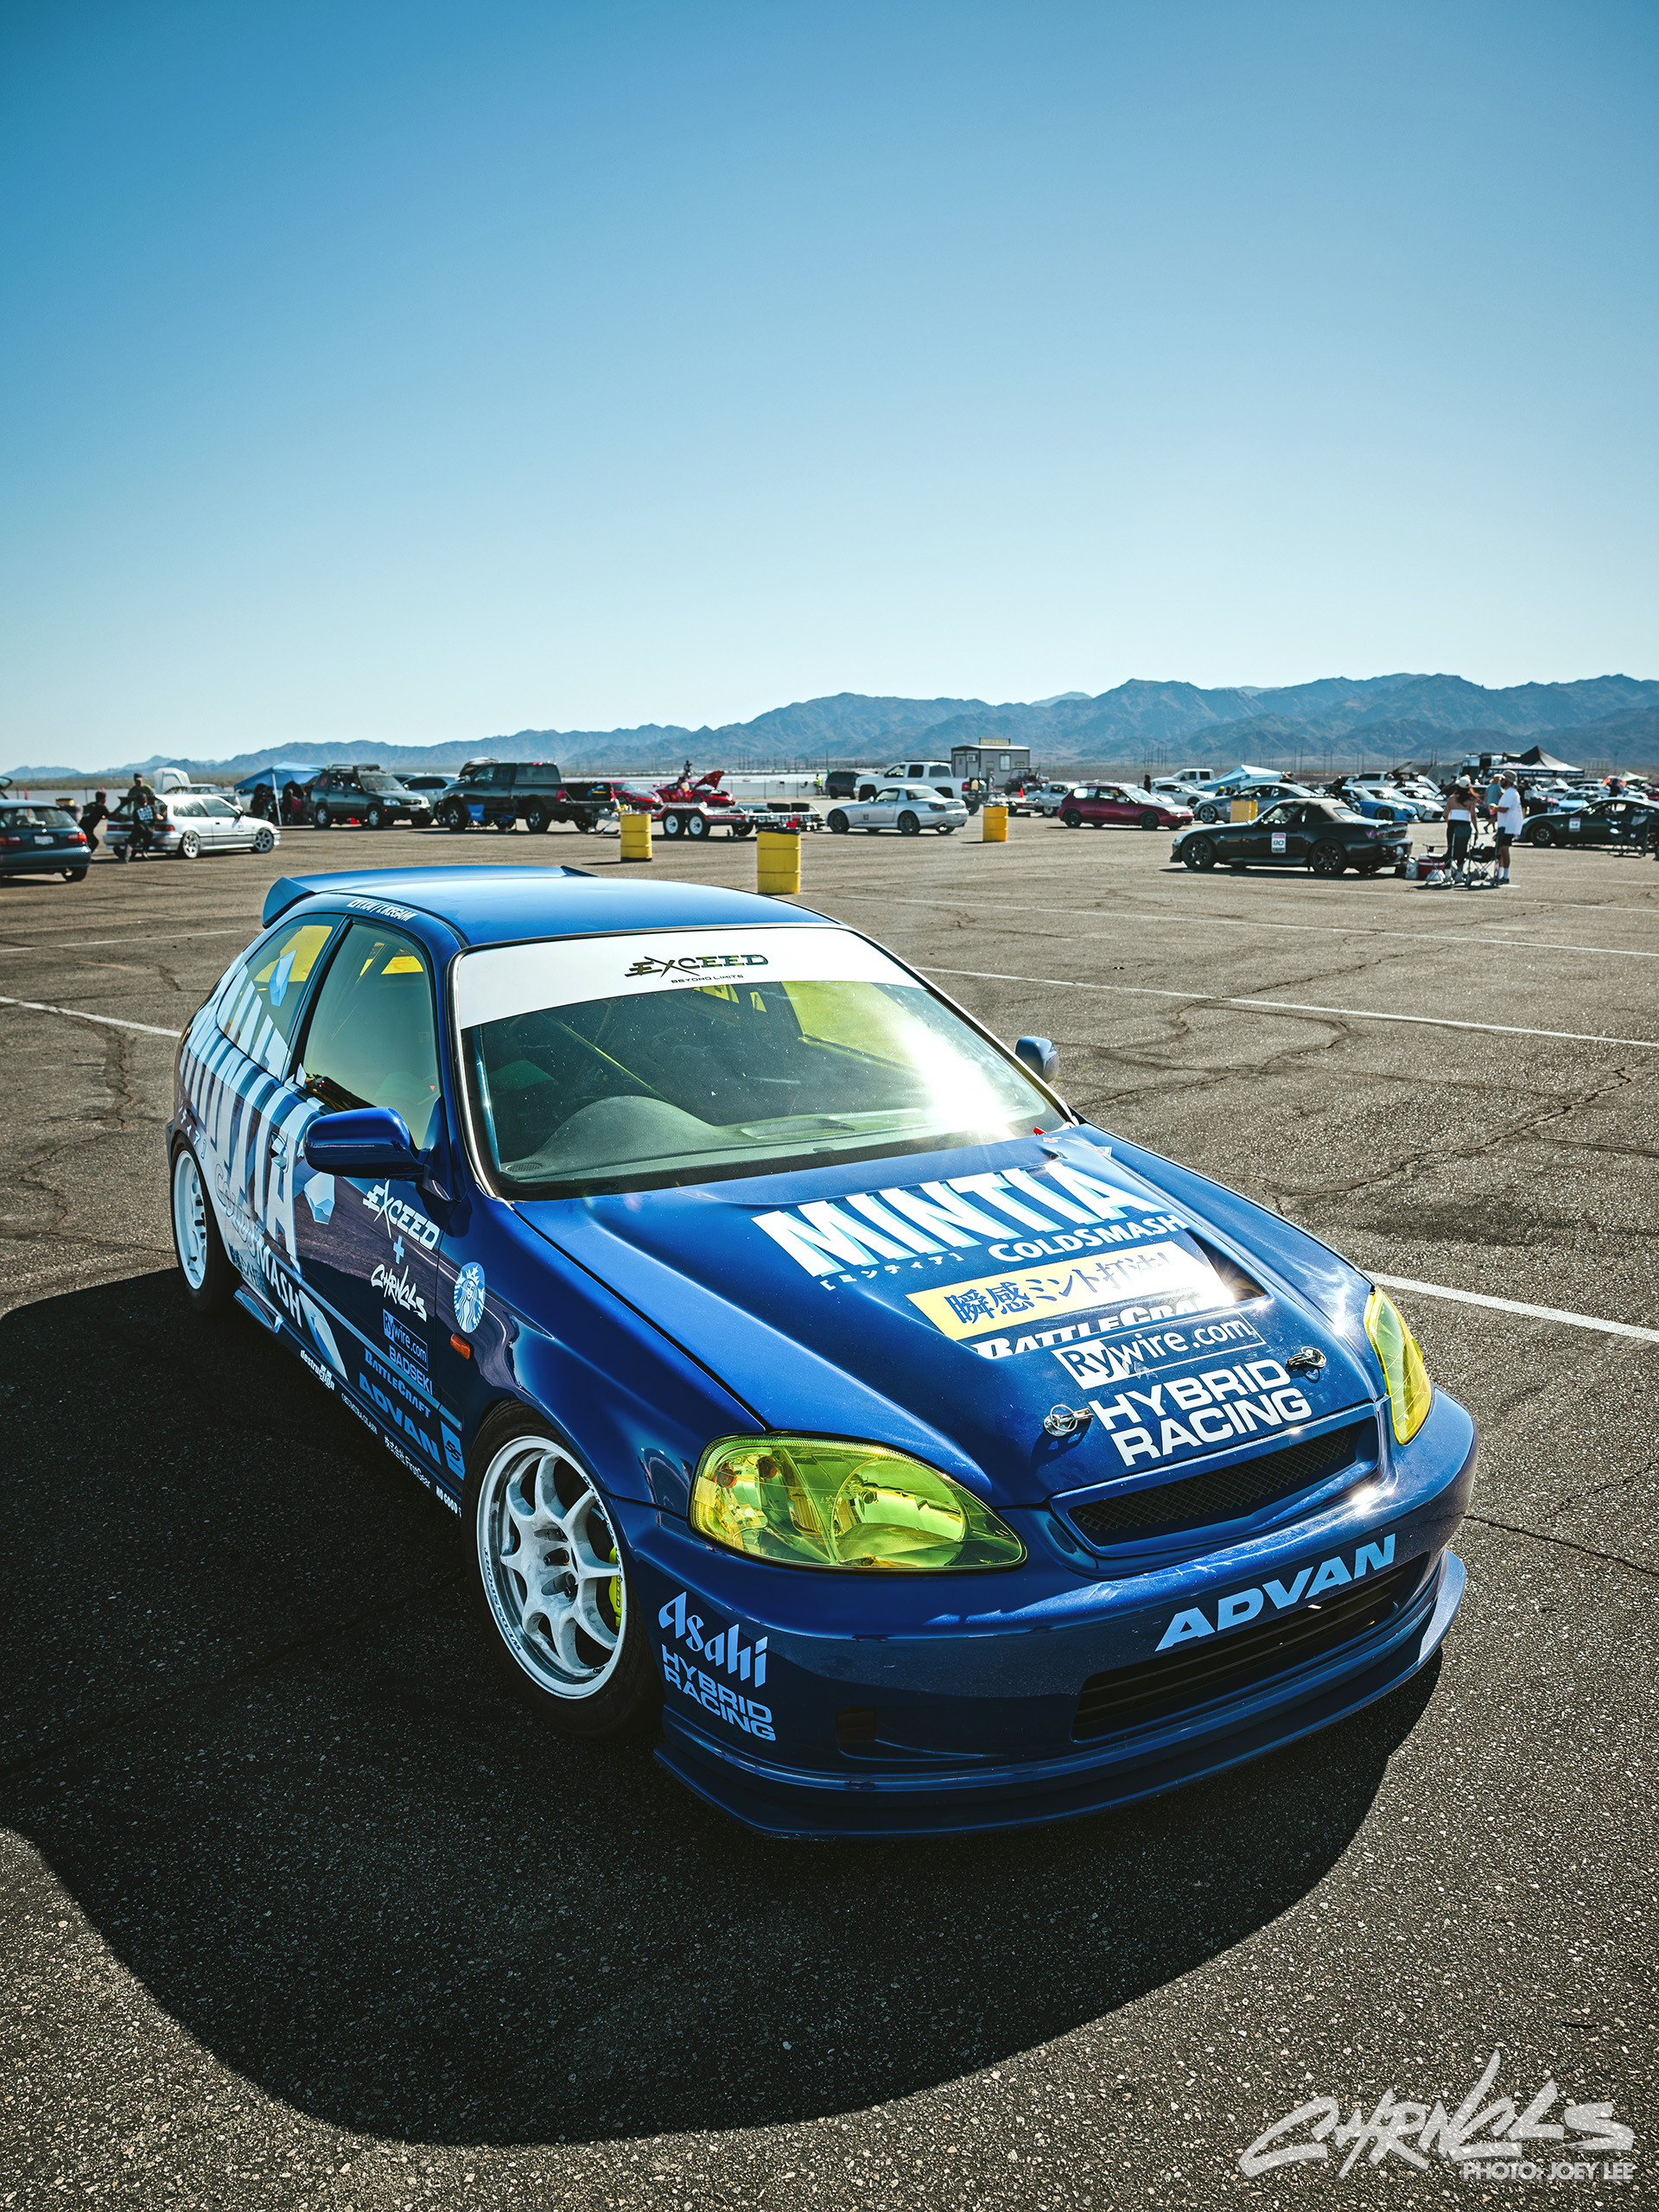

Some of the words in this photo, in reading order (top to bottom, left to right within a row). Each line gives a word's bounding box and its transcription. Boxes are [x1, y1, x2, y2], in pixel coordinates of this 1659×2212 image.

[625, 954, 769, 978] EXCEED
[362, 1179, 441, 1250] EXCEED
[751, 1162, 1169, 1277] MINTIA
[988, 1215, 1192, 1262] COLDSMASH
[384, 1314, 428, 1363] Rywire.com
[389, 1344, 433, 1396] BADSEKI
[1065, 1319, 1253, 1380] Rywire.com
[359, 1371, 442, 1466] ADVAN
[1089, 1358, 1292, 1430] HYBRID
[1111, 1388, 1313, 1467] RACING
[1154, 1532, 1396, 1652] ADVAN
[658, 1591, 768, 1688] Asahi
[661, 1643, 772, 1723] HYBRID
[663, 1663, 777, 1741] RACING
